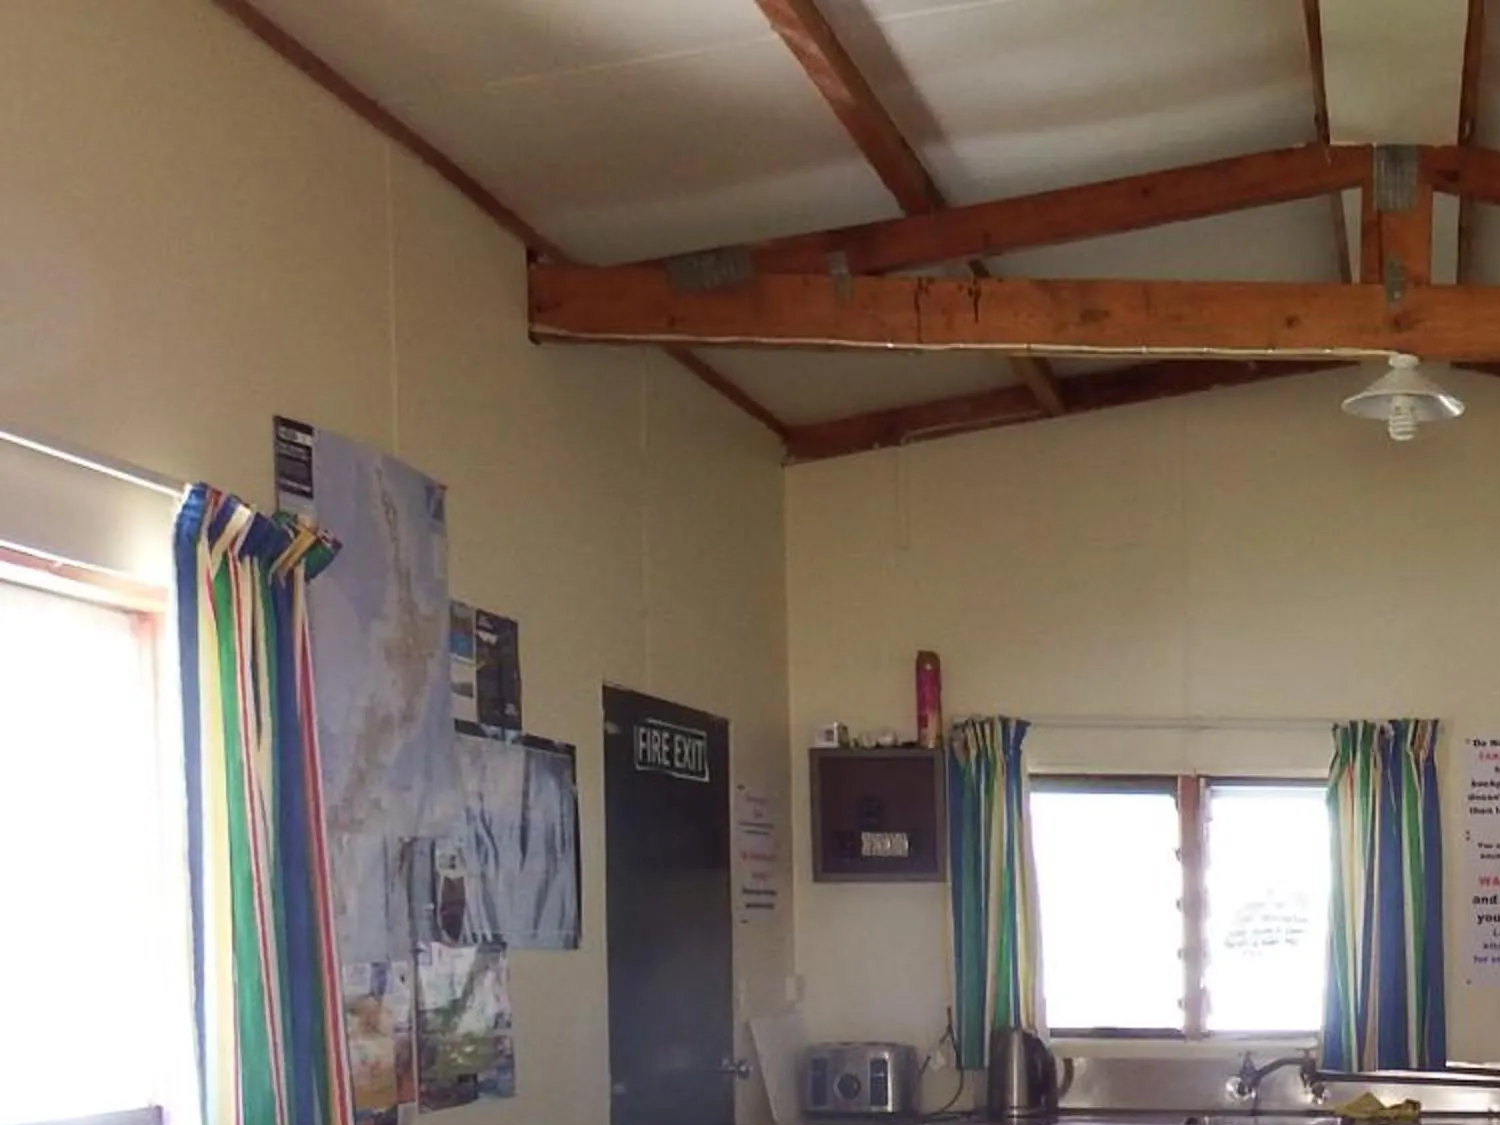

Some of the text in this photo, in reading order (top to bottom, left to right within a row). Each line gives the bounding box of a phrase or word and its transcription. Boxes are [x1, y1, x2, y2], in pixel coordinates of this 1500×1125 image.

[639, 727, 704, 772] FIRE EXIT
[1471, 894, 1498, 905] and
